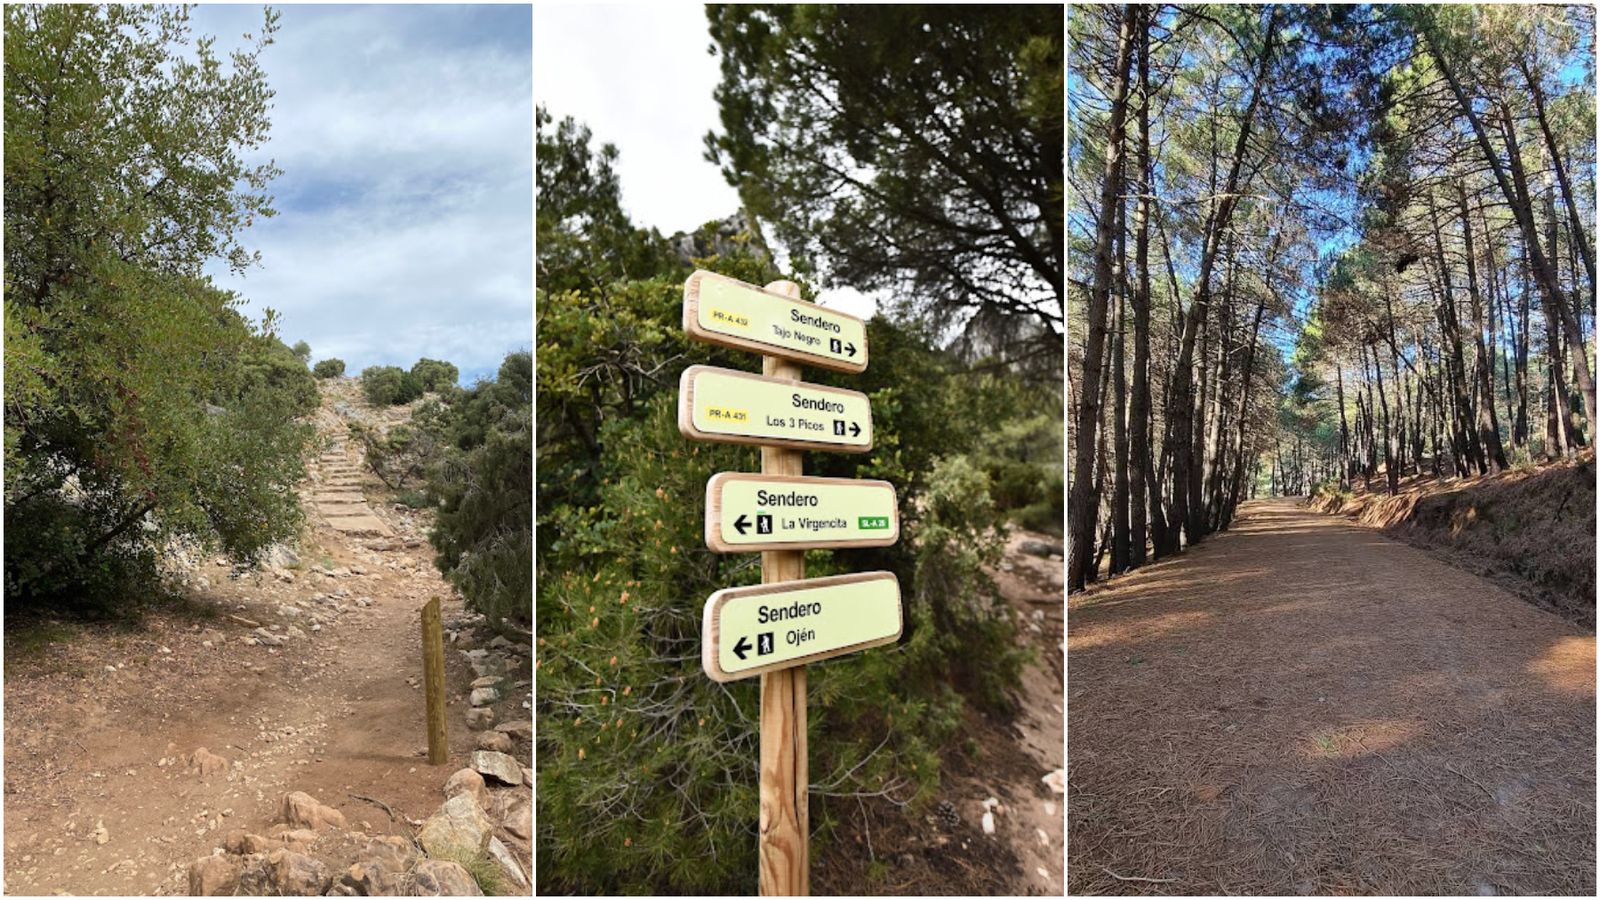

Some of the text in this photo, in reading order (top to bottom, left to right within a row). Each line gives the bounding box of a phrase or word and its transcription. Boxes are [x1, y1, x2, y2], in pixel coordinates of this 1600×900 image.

[790, 308, 841, 333] Sendero
[772, 324, 821, 345] Tajo Negro
[792, 393, 844, 414] Sendero
[709, 409, 731, 419] PR-A
[766, 415, 824, 431] Los 3 Picos
[757, 489, 818, 507] Sendero
[781, 517, 848, 532] La Virgencita
[758, 601, 822, 624] Sendero
[786, 627, 816, 647] Ojén
